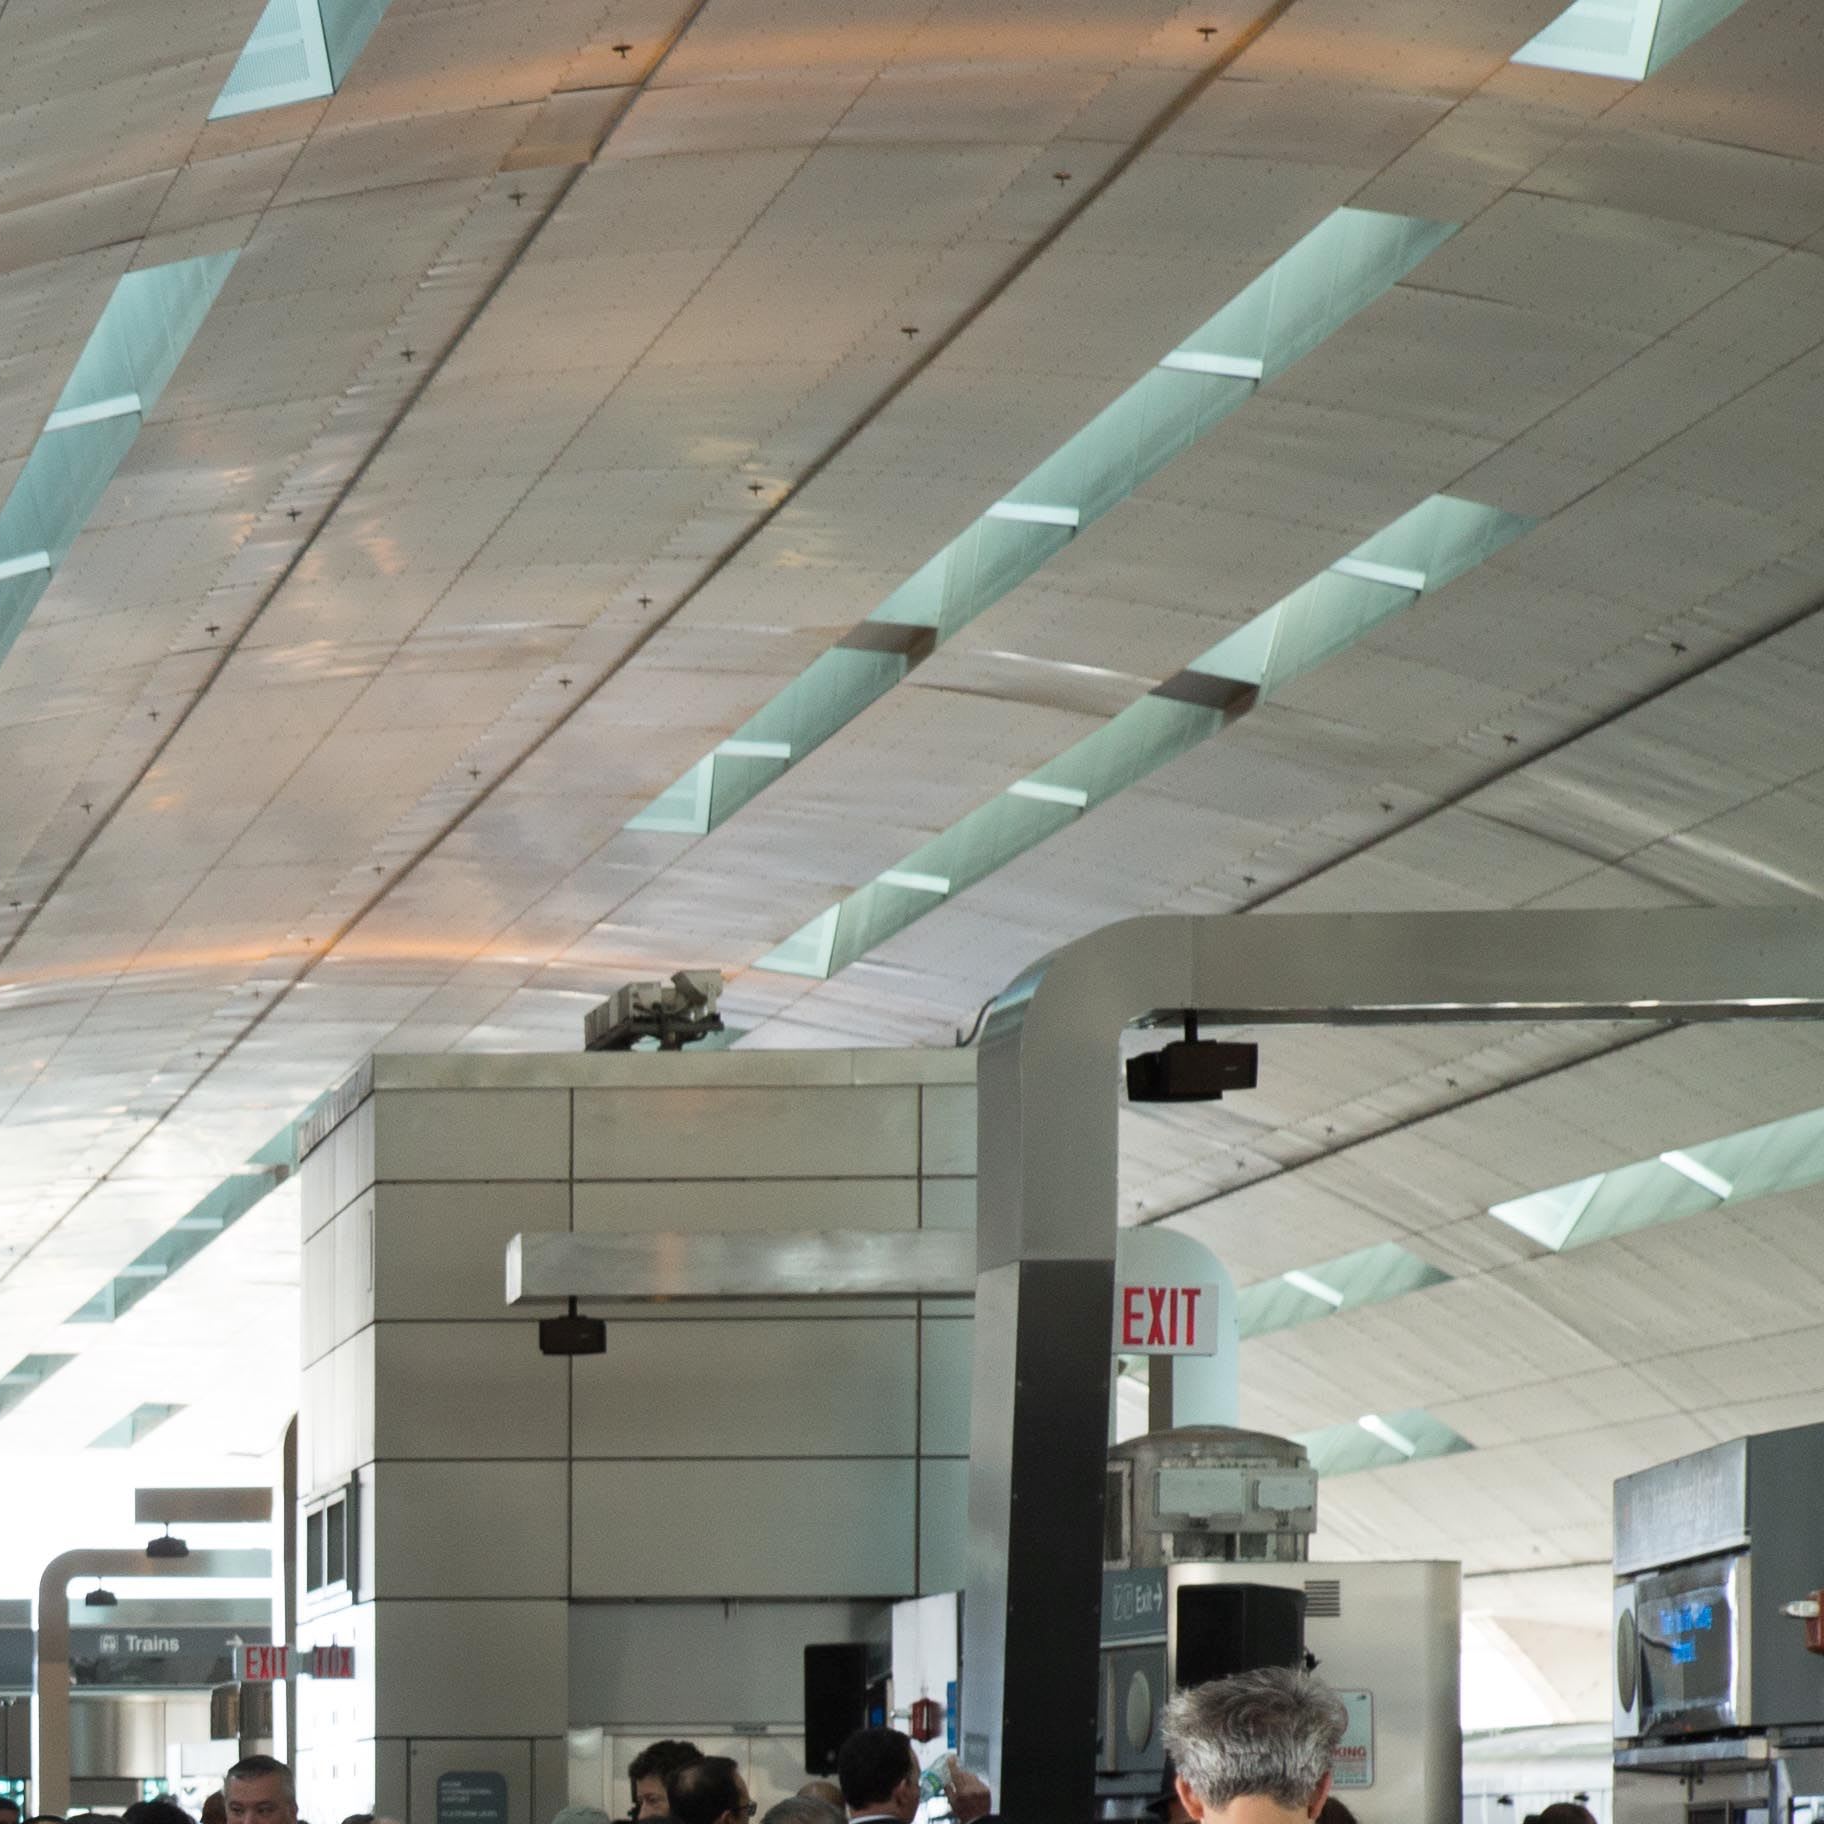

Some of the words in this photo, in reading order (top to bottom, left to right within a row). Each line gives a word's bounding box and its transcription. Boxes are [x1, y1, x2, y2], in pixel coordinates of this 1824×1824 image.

[1121, 1286, 1202, 1347] EXIT
[125, 1635, 181, 1653] Trains
[246, 1646, 289, 1679] EXIT
